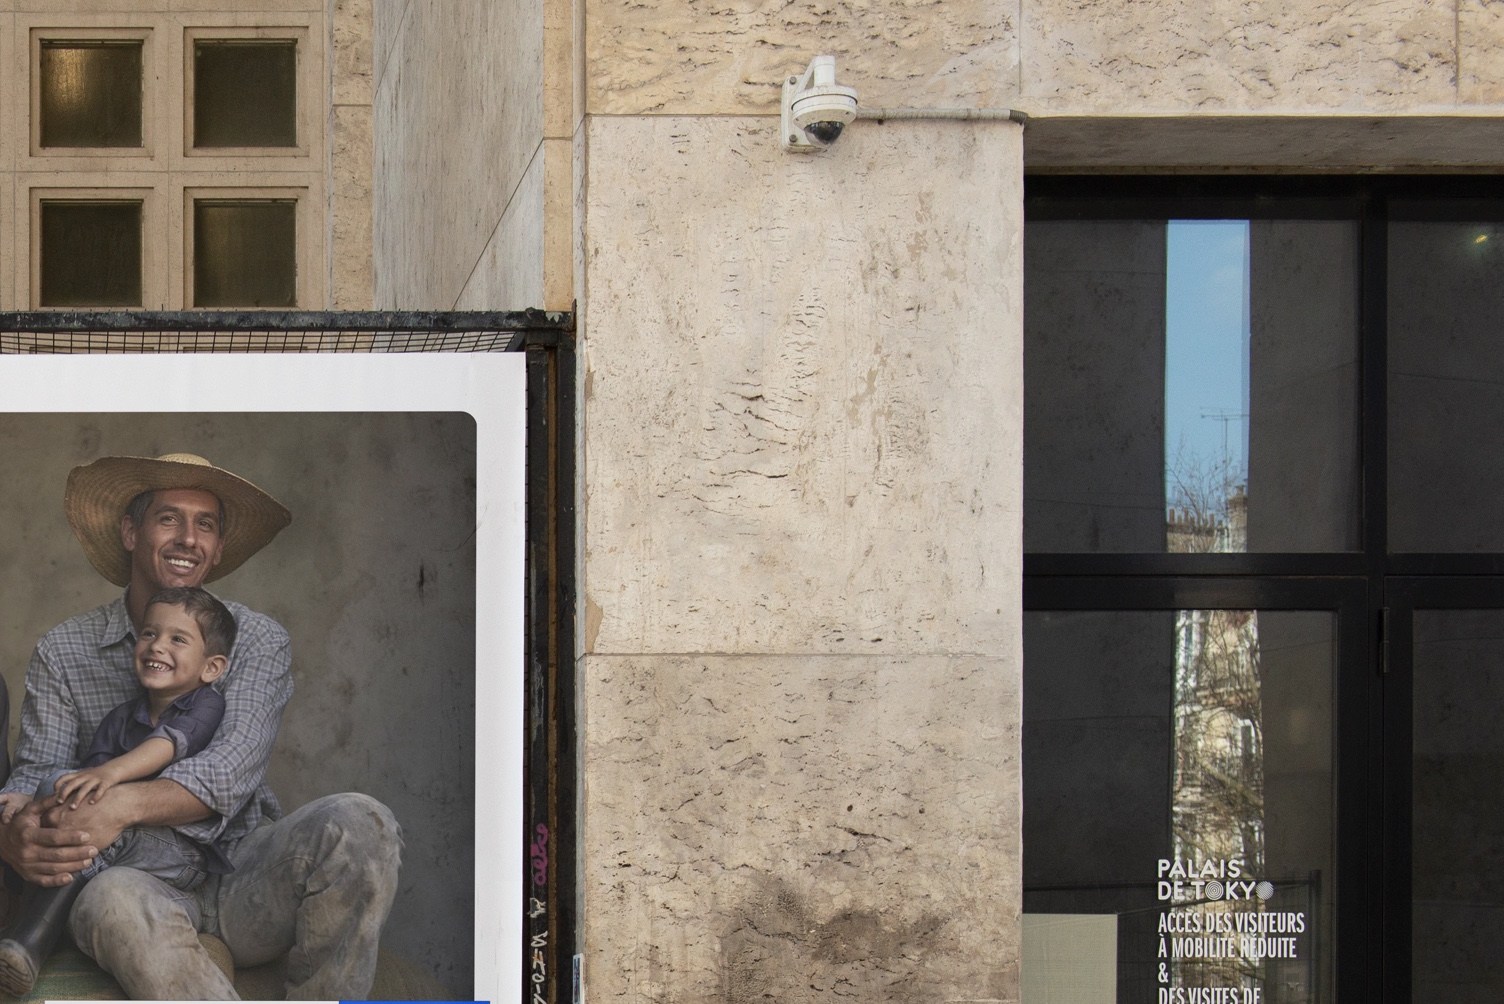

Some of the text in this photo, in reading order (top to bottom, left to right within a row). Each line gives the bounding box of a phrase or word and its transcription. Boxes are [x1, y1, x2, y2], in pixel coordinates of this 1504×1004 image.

[1158, 859, 1241, 878] PALAIS
[1158, 880, 1274, 900] DE TOKYO
[1205, 912, 1232, 933] DES
[1235, 912, 1305, 933] VISITEURS
[1158, 934, 1297, 958] À MOBILITÉ RÉDUITE
[1158, 962, 1169, 983] &
